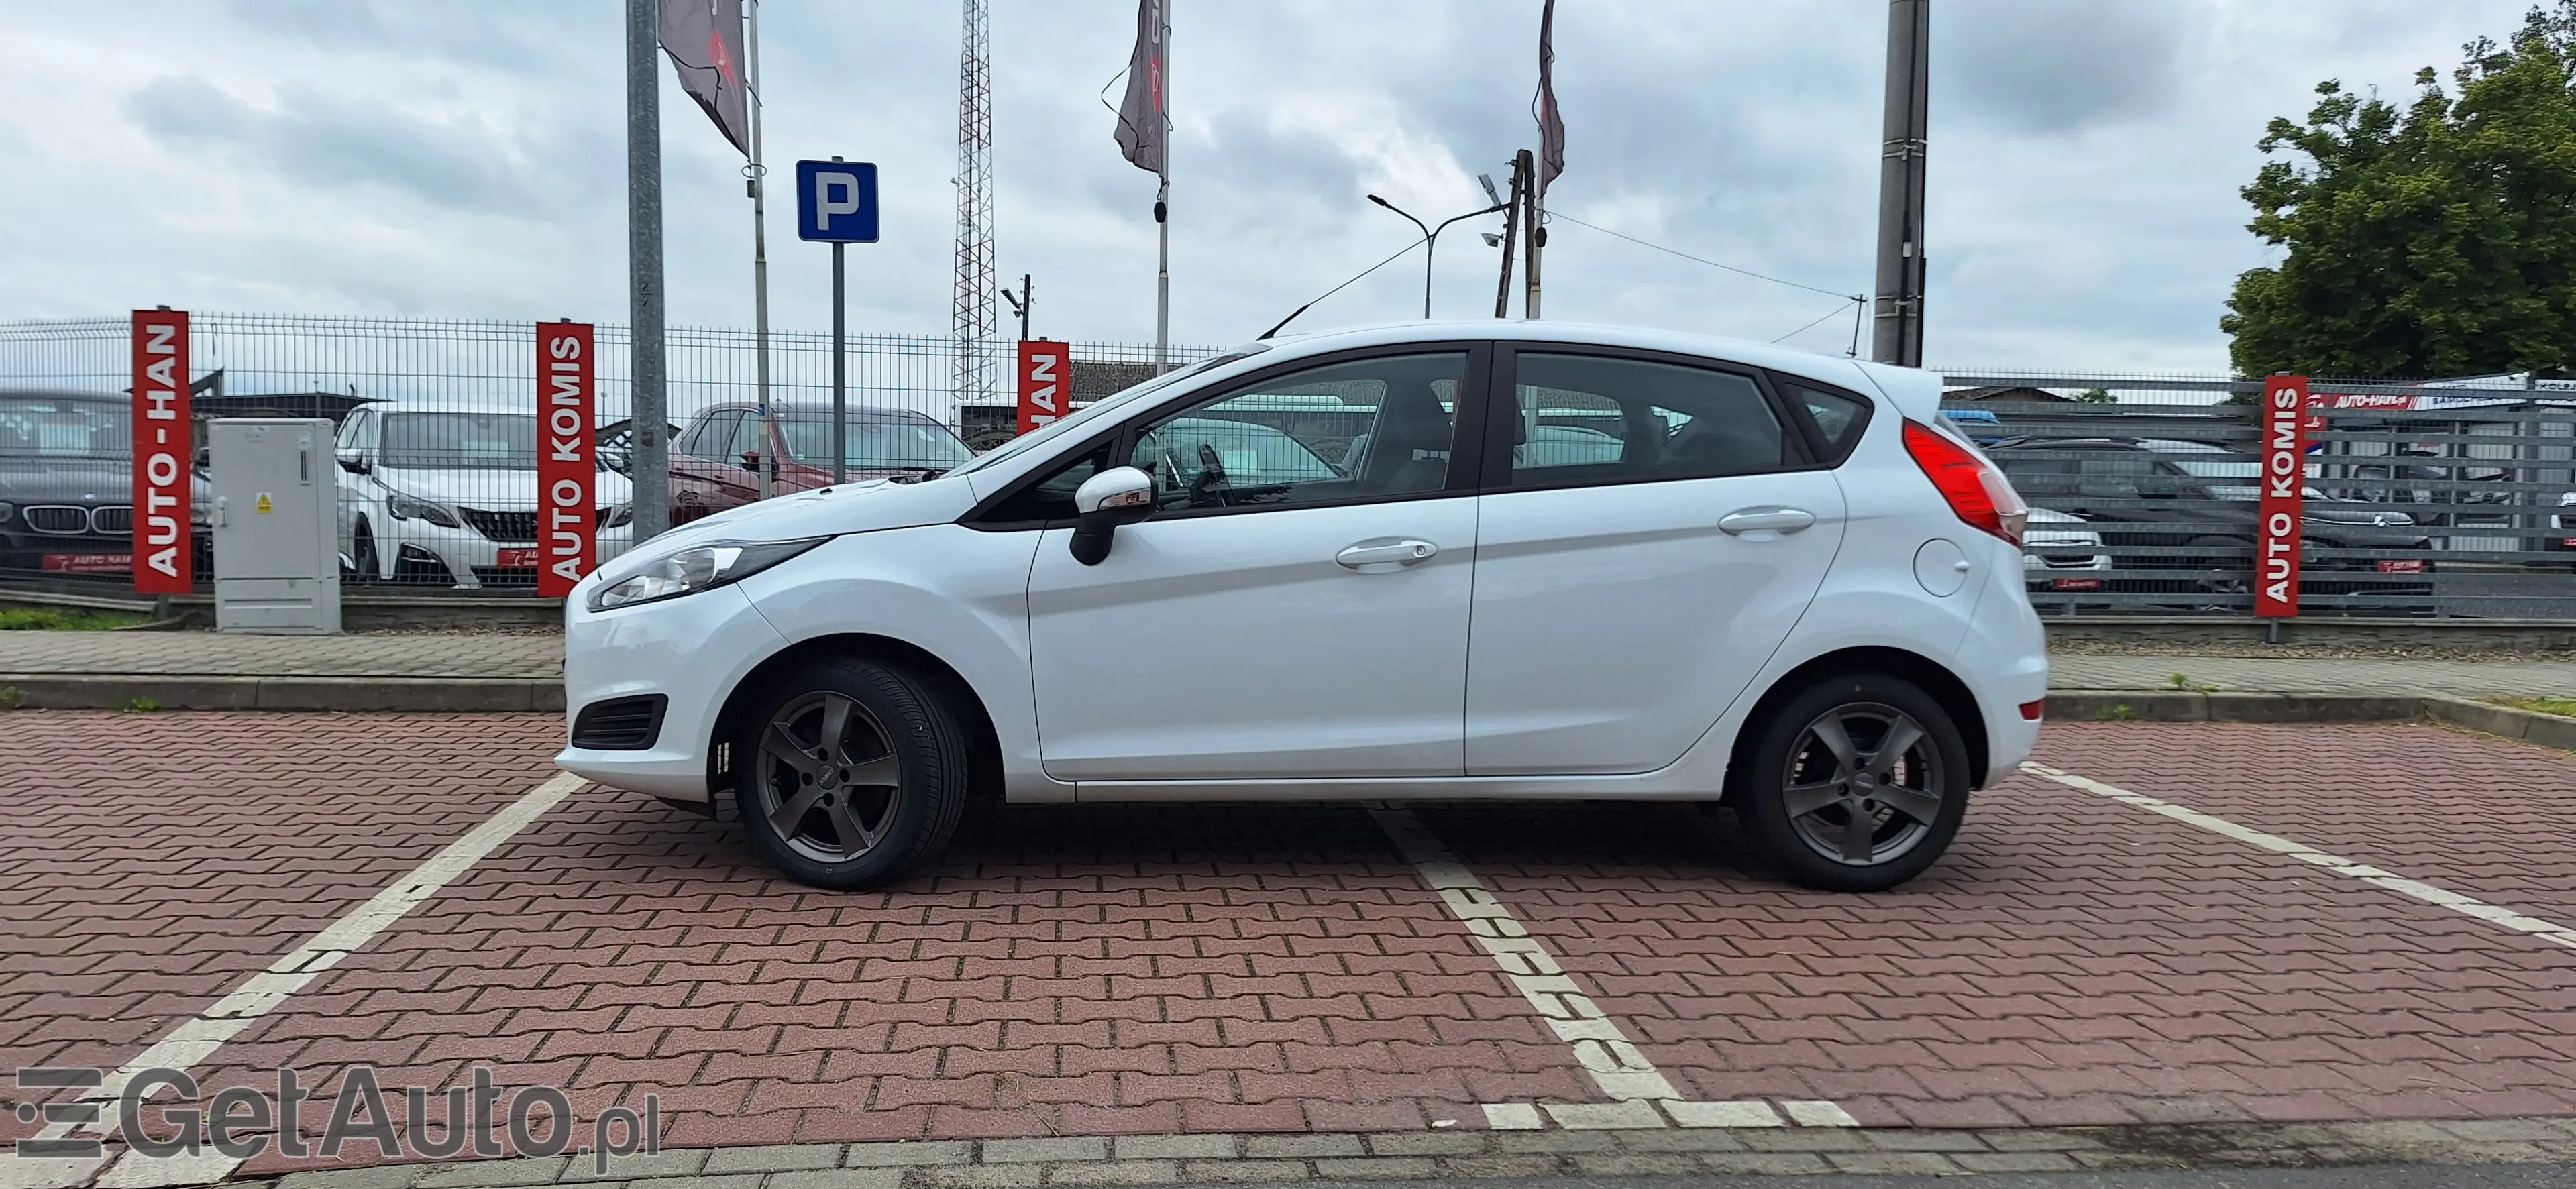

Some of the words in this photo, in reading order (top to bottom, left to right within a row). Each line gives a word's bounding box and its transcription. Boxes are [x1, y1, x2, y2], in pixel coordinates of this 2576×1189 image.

[815, 172, 859, 231] P
[146, 324, 178, 577] AUTO-HAN
[550, 337, 581, 461] KOMIS
[2270, 388, 2298, 497] KOMIS
[551, 479, 582, 582] AUTO
[2266, 513, 2292, 604] AUTO
